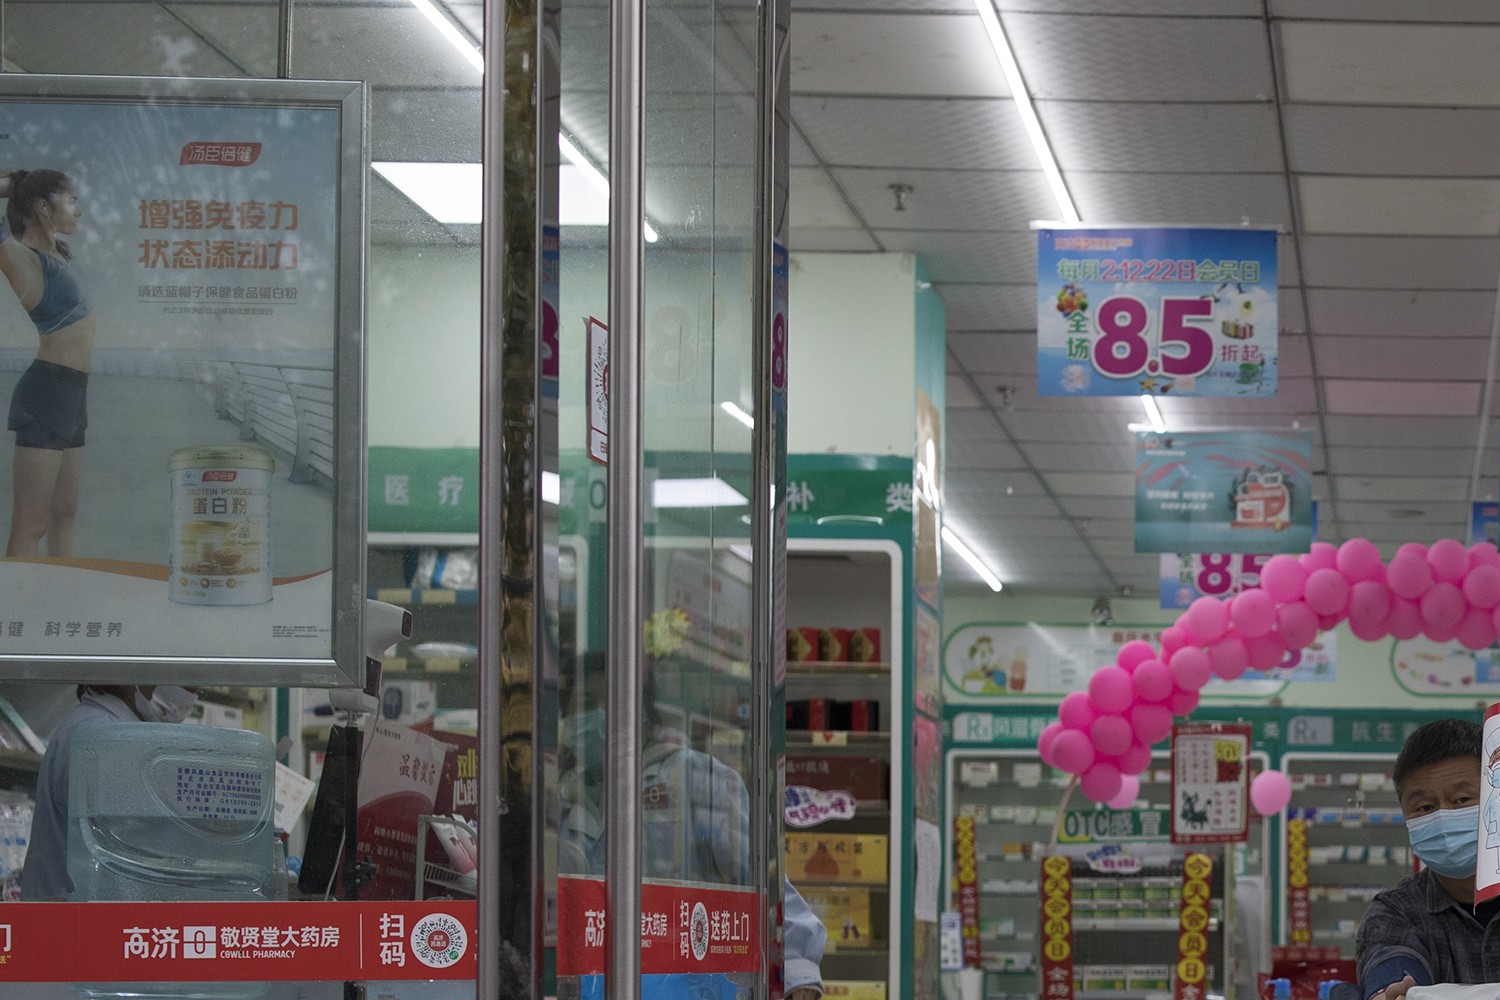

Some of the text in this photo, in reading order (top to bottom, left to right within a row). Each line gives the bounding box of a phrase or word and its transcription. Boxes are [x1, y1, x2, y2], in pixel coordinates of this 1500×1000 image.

[188, 145, 252, 162] 汤臣倍健
[138, 200, 298, 231] 增强免疫力
[138, 239, 298, 270] 状态添动力
[138, 284, 298, 300] 请选蓝帽子保健食品蛋白粉
[1066, 310, 1089, 361] 全场
[1093, 296, 1214, 377] 8.5
[1221, 344, 1264, 363] 折起
[192, 497, 248, 515] 蛋白粉
[384, 474, 465, 507] 医疗
[44, 621, 124, 638] 科学营养
[1063, 811, 1108, 837] OTC
[220, 926, 340, 948] 敬贤堂大药房
[379, 912, 406, 968] 扫码
[680, 900, 690, 960] 扫码
[710, 910, 750, 942] 送药上门
[123, 926, 180, 959] 高济
[253, 949, 296, 959] PHARMACY
